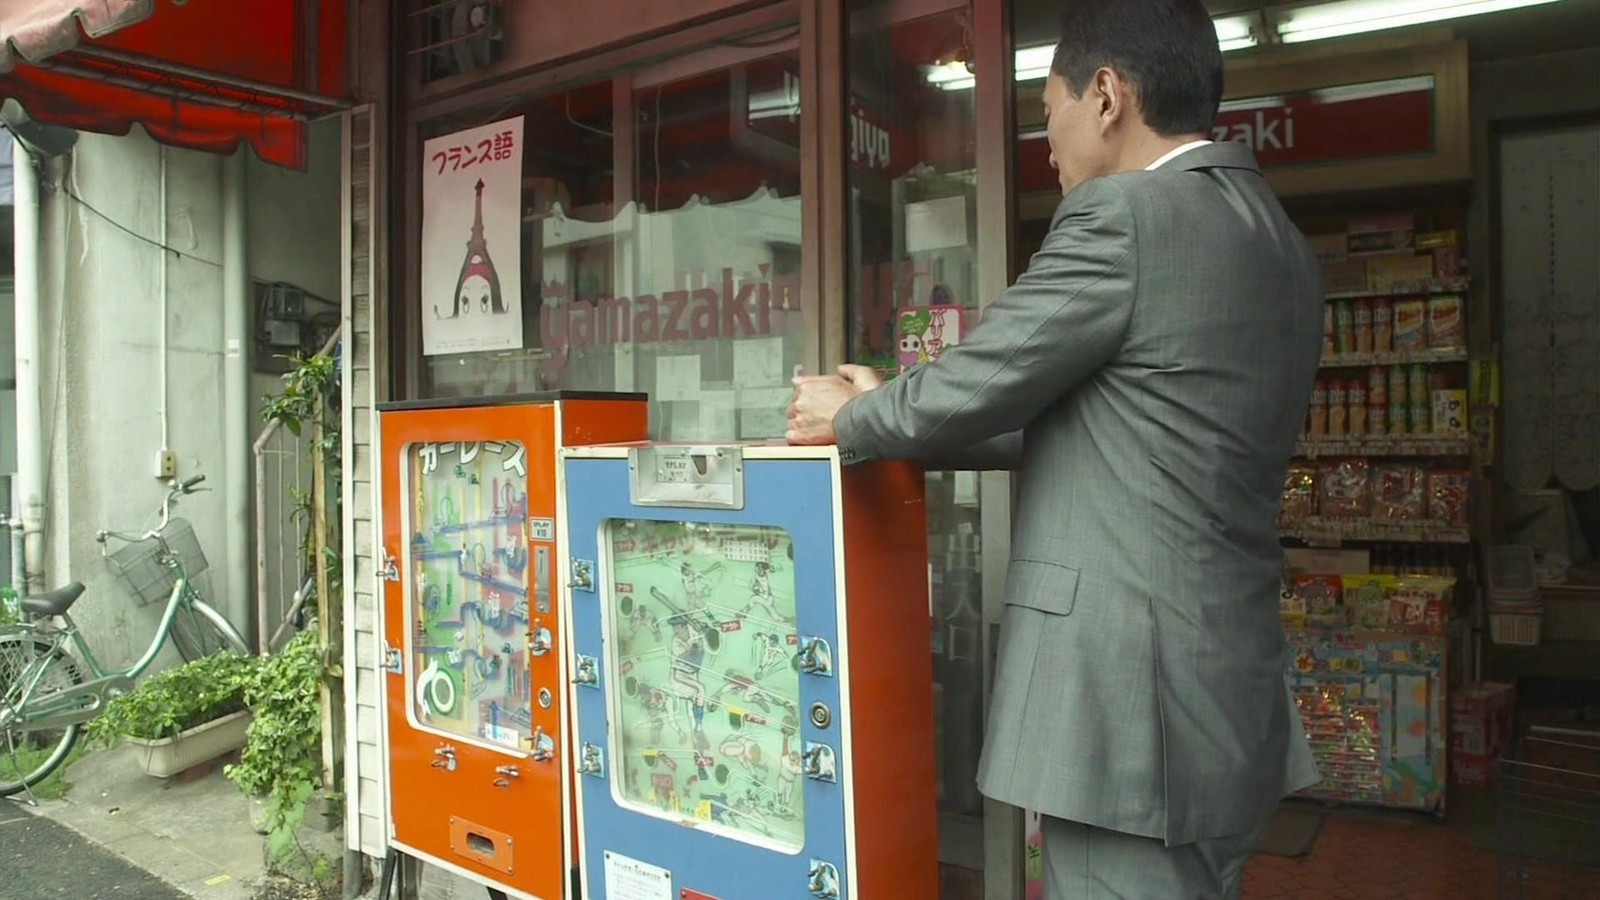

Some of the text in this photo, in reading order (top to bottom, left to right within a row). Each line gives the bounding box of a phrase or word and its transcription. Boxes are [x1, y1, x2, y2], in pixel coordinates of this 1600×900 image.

[432, 131, 513, 175] フランス語
[540, 263, 771, 370] yamazaki
